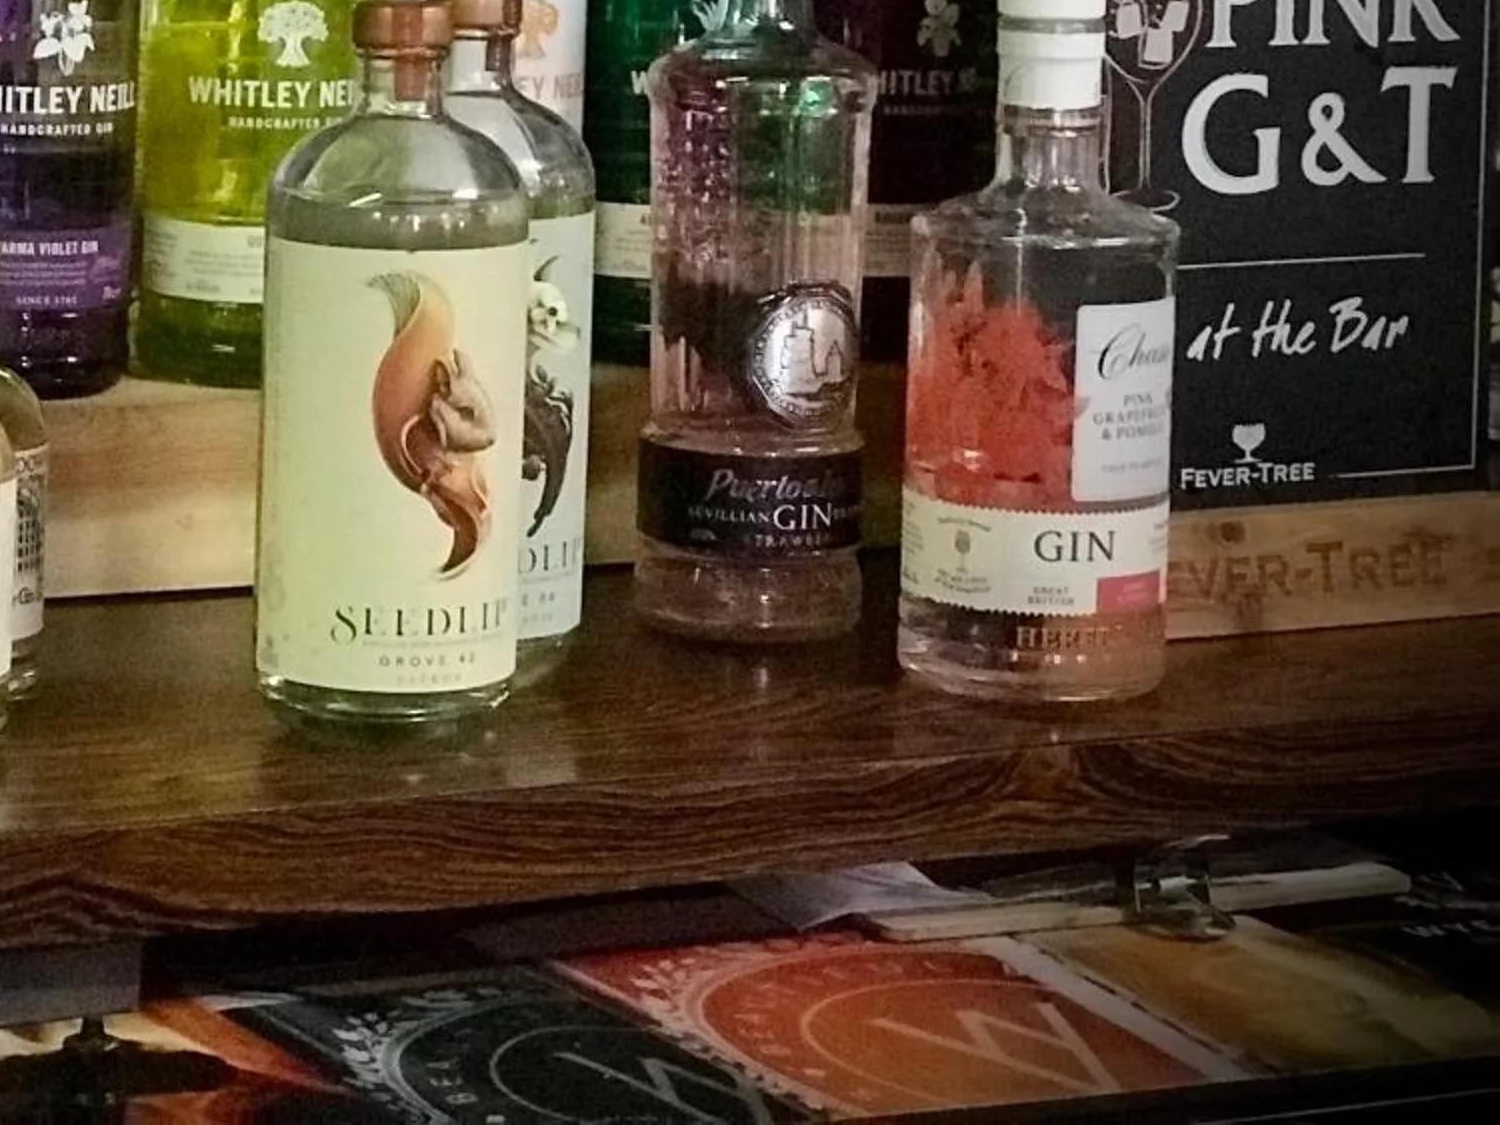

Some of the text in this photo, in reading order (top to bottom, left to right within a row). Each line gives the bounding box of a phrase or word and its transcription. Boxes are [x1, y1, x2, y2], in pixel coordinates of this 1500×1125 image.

[89, 81, 136, 113] NEILL
[187, 75, 311, 109] WHITLEY
[877, 68, 955, 97] HITLEY
[0, 122, 114, 136] HANDCRAFTED GIN
[227, 115, 320, 130] HANDCRAFTED
[1181, 64, 1459, 195] G&T
[39, 240, 79, 256] VIOLET
[81, 239, 99, 255] GIN
[1186, 295, 1410, 363] at the Bar
[1096, 321, 1170, 380] Chas
[1180, 461, 1316, 490] FEVER-TREE
[772, 502, 833, 531] GIN
[1033, 530, 1117, 563] GIN
[330, 597, 510, 647] SEEDLIP
[378, 653, 446, 669] GROVE
